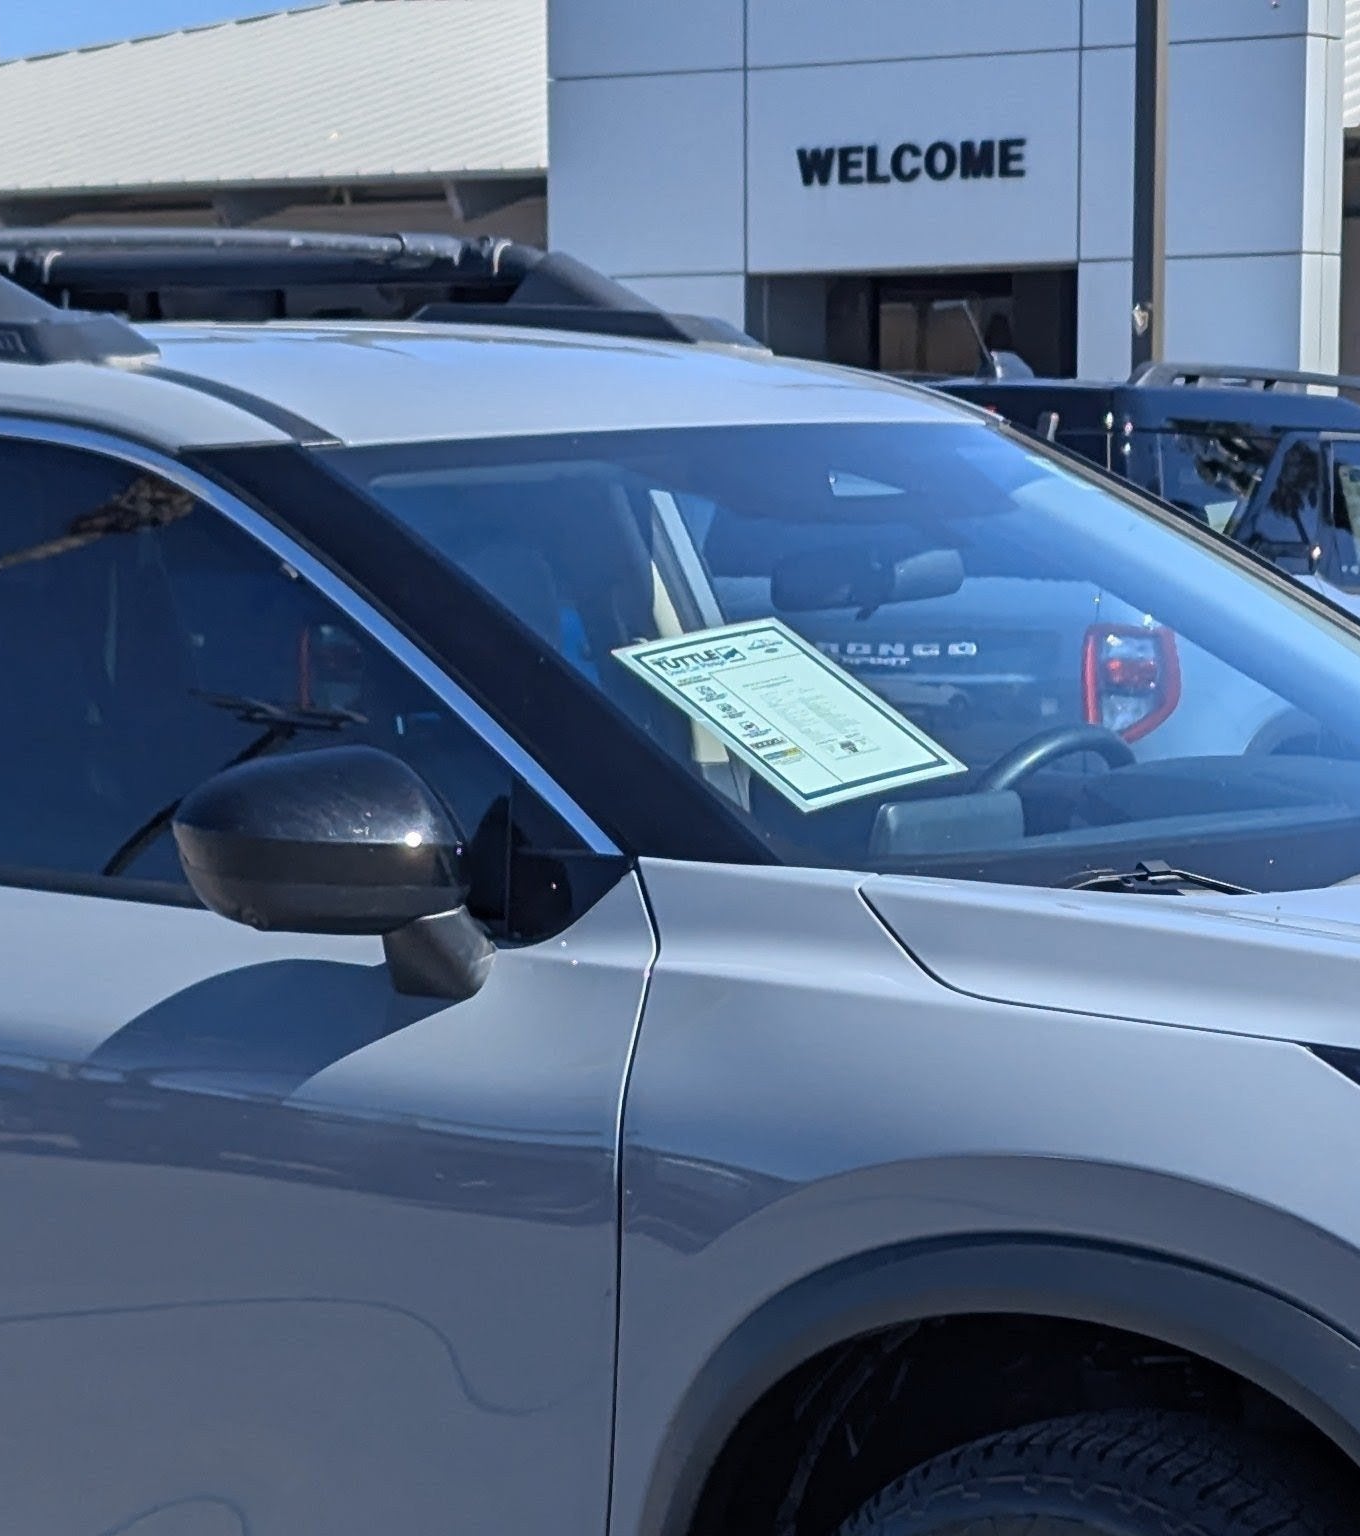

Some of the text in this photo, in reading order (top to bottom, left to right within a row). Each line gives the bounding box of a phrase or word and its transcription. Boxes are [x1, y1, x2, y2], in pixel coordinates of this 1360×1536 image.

[796, 138, 1027, 187] WELCOME
[652, 649, 721, 671] TUTTLE
[816, 641, 978, 657] RONCO
